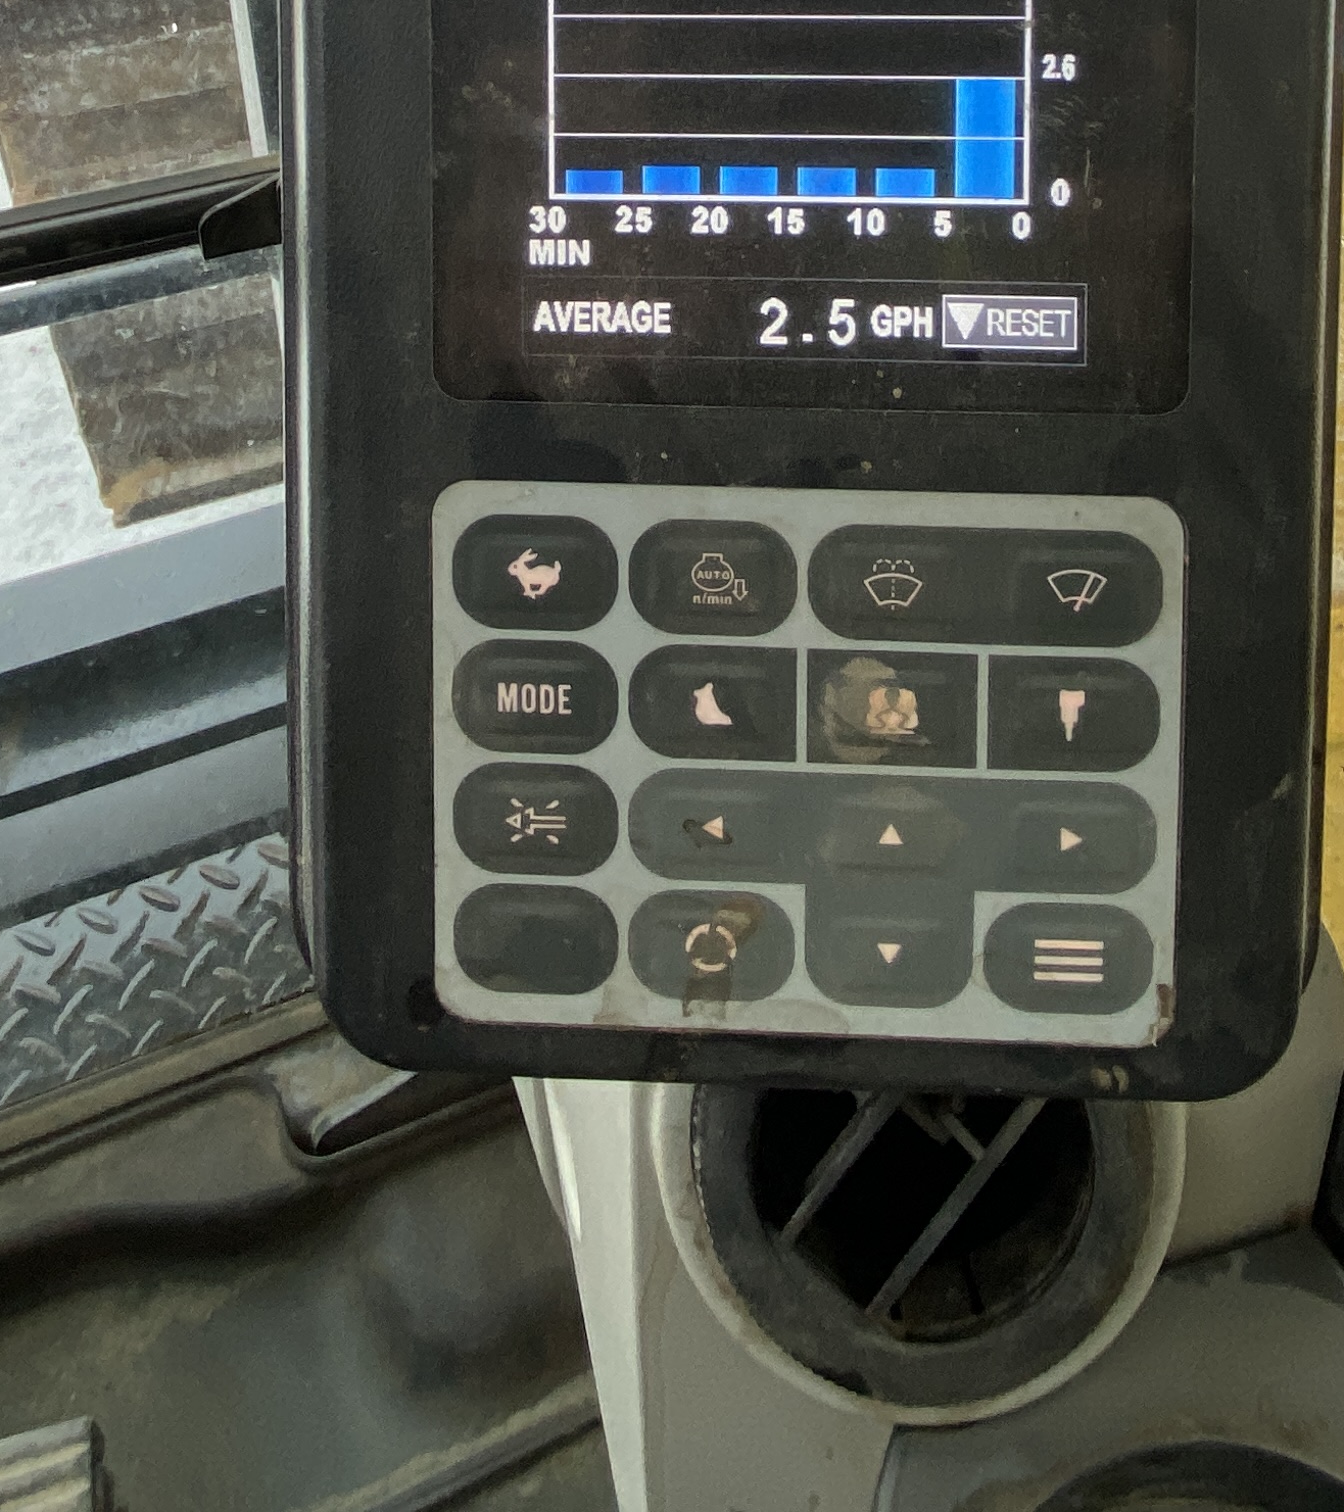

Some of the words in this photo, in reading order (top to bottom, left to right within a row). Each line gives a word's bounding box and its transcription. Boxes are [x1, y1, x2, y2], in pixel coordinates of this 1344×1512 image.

[1042, 53, 1076, 81] 2.6
[1051, 178, 1071, 207] 0
[529, 206, 567, 234] 30
[614, 205, 652, 234] 25
[691, 206, 729, 234] 20
[768, 207, 805, 235] 15
[847, 208, 886, 236] 10
[933, 210, 953, 238] 5
[1011, 211, 1031, 240] 0
[529, 239, 591, 266] MIN
[533, 300, 672, 335] AVERAGE
[759, 297, 858, 347] 2.5
[870, 303, 935, 339] GPH
[986, 308, 1072, 340] RESET
[696, 570, 730, 580] AUTO
[692, 591, 733, 605] n/min
[497, 682, 573, 716] MODE
